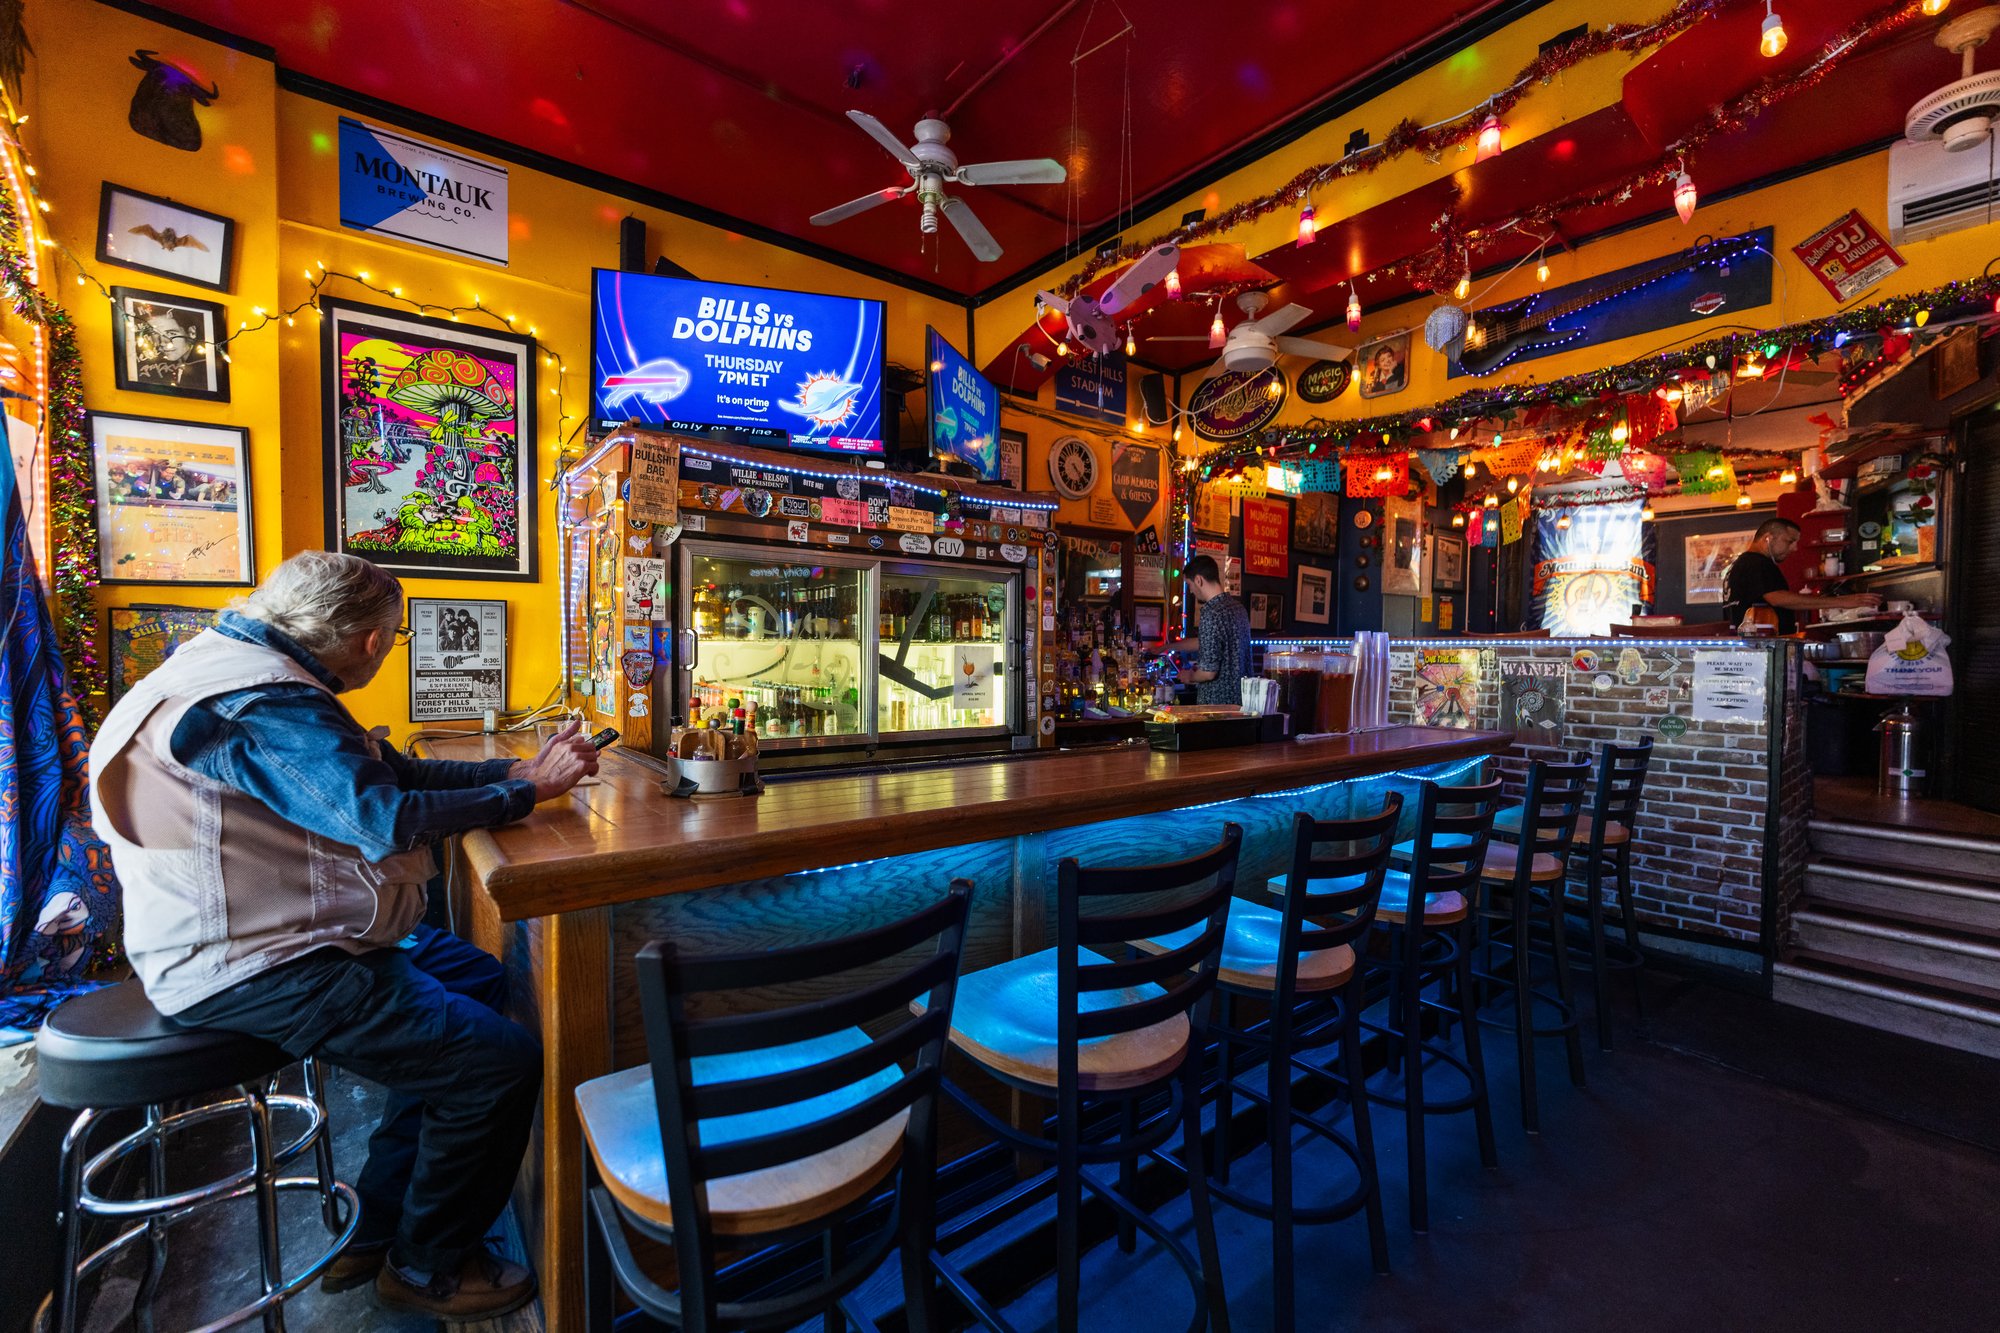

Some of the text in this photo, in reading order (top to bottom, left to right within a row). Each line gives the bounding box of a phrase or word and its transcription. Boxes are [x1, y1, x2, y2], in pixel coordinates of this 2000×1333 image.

[355, 152, 494, 212] MONTAUK
[377, 184, 476, 220] BREWING CO.
[1804, 236, 1837, 267] Redbreast
[1843, 238, 1880, 263] LIQUEUR
[697, 296, 795, 327] BILLS VS
[672, 317, 813, 352] DOLPHINS
[704, 354, 783, 374] THURSDAY
[1067, 357, 1124, 383] OREST HILLS
[718, 371, 769, 387] 7PM ET
[958, 365, 976, 391] BILLS
[1308, 367, 1342, 385] MAGIC
[1071, 375, 1114, 399] STADIUM
[1310, 380, 1338, 393] HAT
[717, 394, 770, 409] It's on prime
[952, 377, 986, 417] DOLPHINS
[672, 421, 703, 432] Only
[1218, 402, 1274, 436] ANNIVERSARY
[635, 449, 678, 466] BULLSHIT
[646, 464, 665, 476] BAG
[731, 468, 789, 483] WILLIE NELSON
[752, 479, 784, 489] PRESIDENT
[803, 479, 824, 490] BITE ME!
[1131, 476, 1158, 490] MEMBERS
[868, 497, 889, 507] DON'T
[1129, 490, 1152, 503] GUESTS
[789, 500, 806, 510] Your
[868, 514, 889, 523] DICK
[1250, 509, 1282, 525] MUMFORD
[150, 529, 206, 545] CHEF
[1261, 525, 1279, 538] SONS
[938, 541, 962, 555] FUV
[1246, 540, 1288, 555] FOREST HILLS
[1253, 555, 1280, 568] STADIUM
[130, 620, 205, 639] Still Truck
[1424, 655, 1436, 664] ONE
[1502, 662, 1566, 678] WANEE
